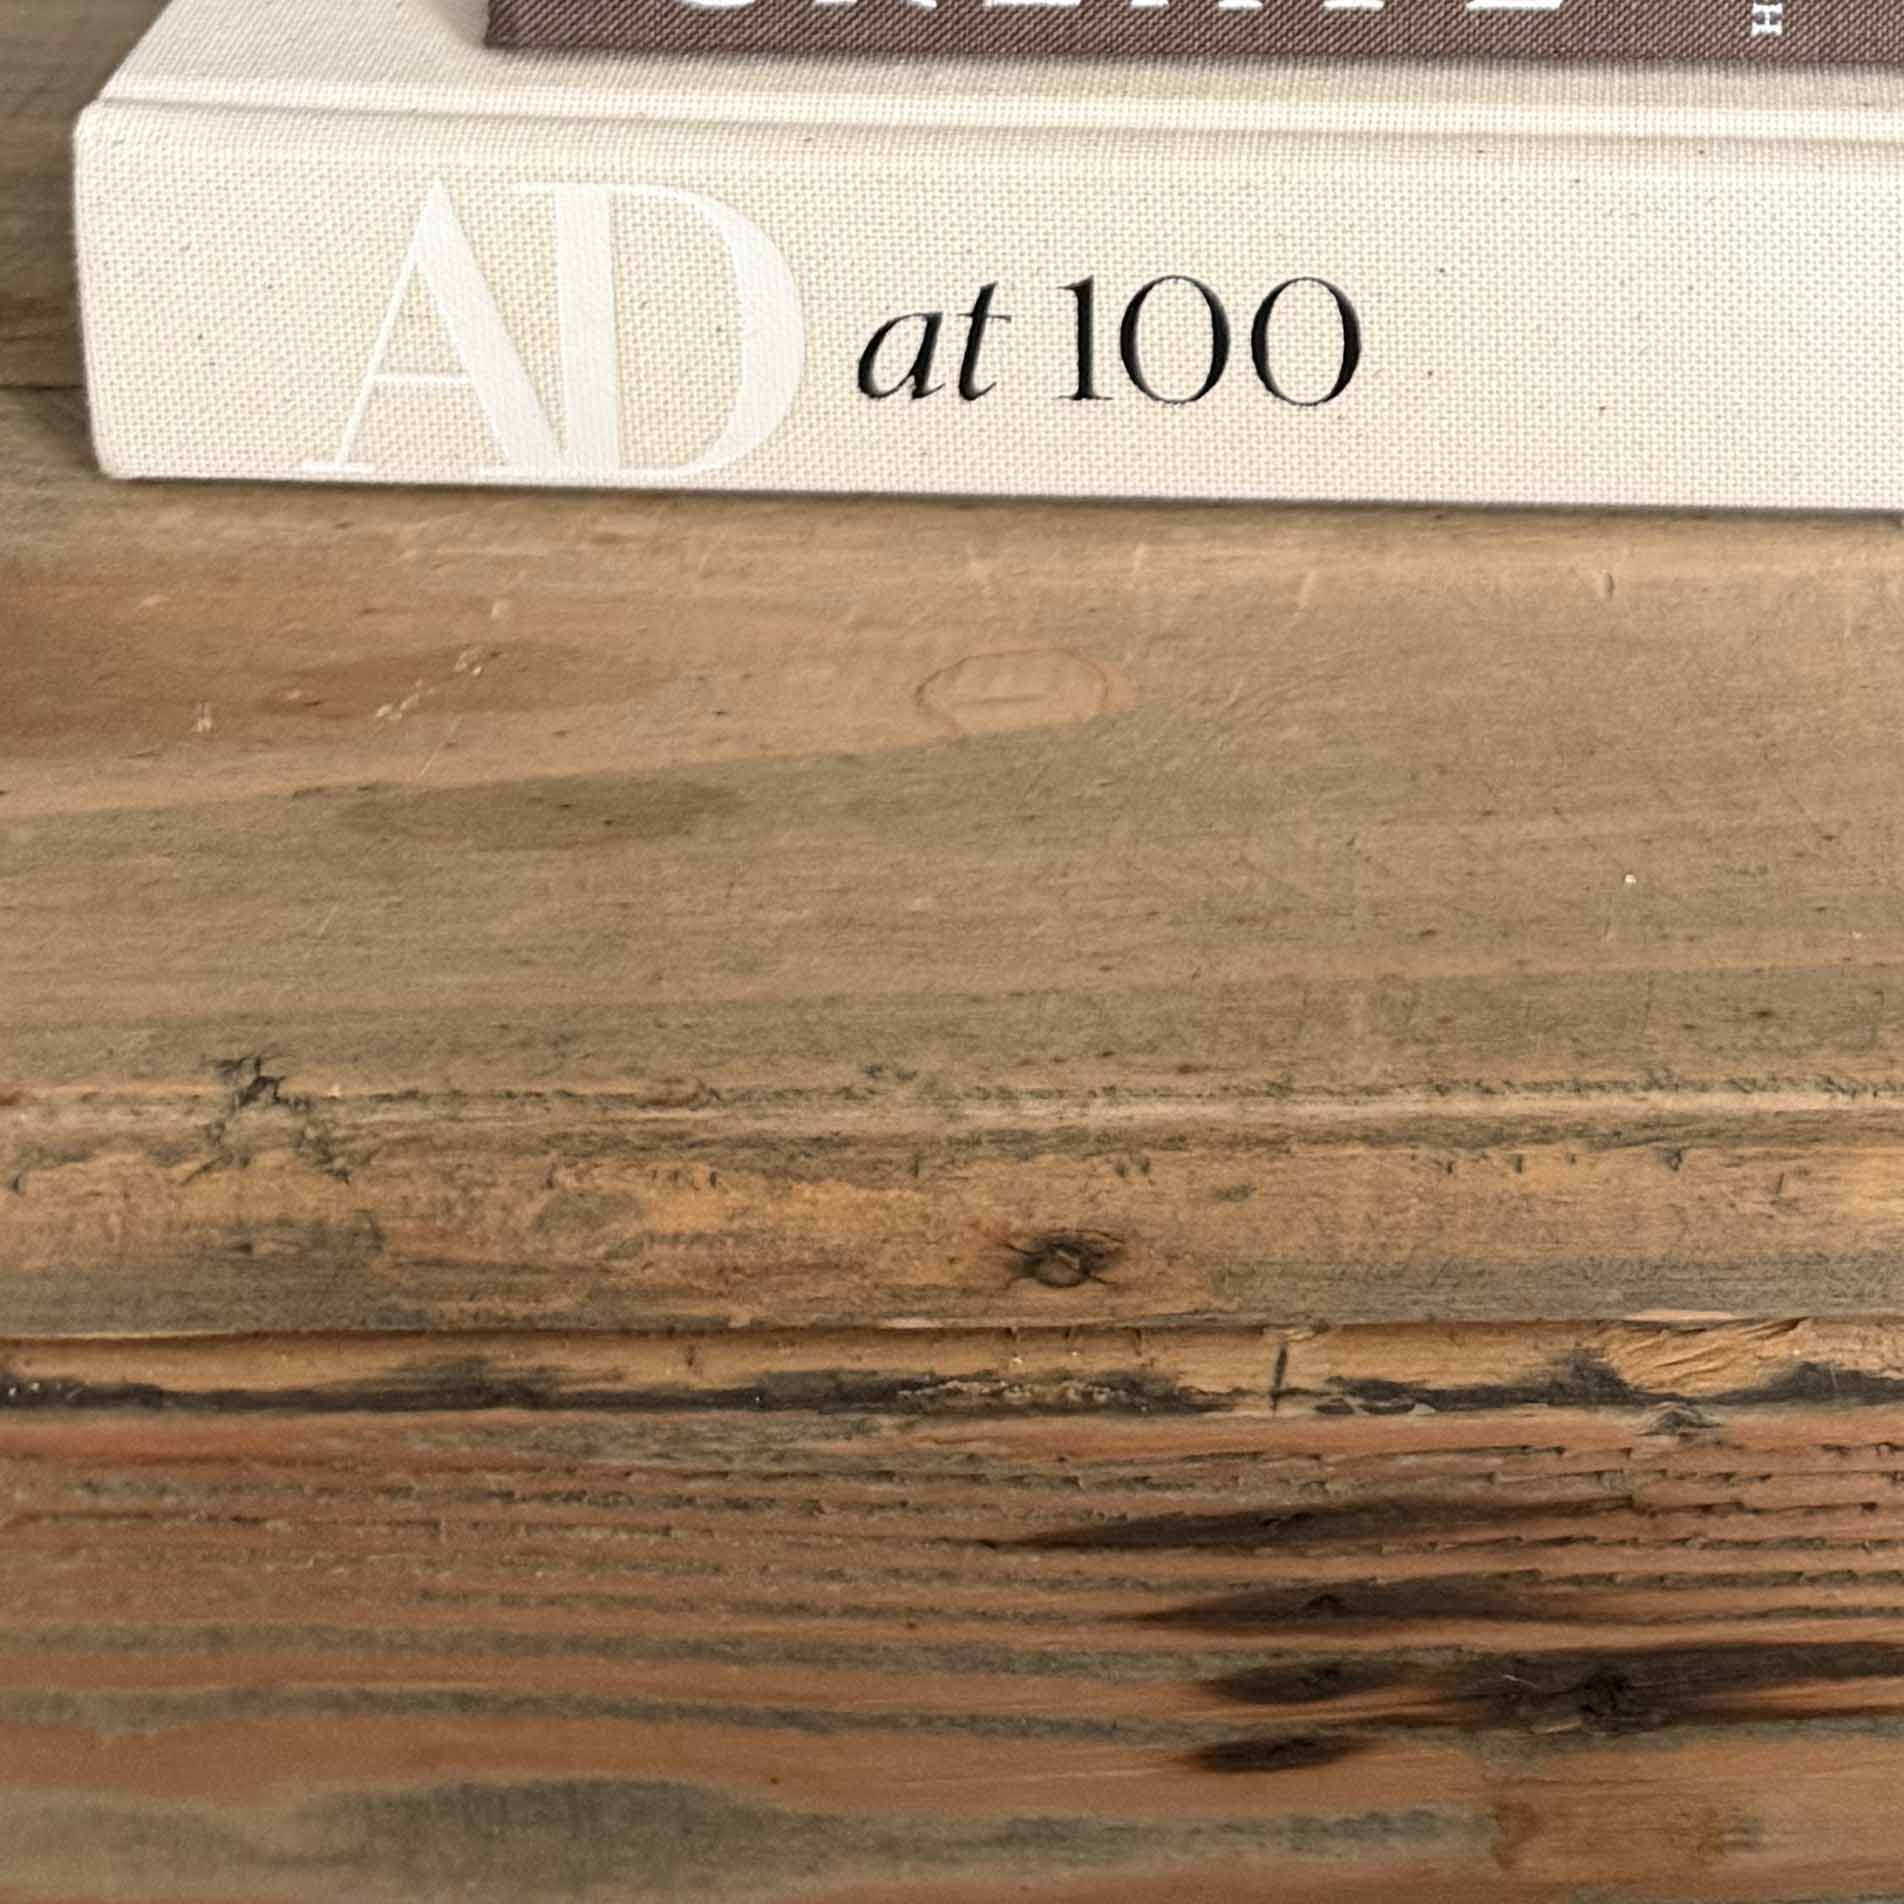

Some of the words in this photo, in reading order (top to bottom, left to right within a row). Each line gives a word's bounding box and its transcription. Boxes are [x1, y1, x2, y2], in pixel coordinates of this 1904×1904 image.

[292, 181, 805, 477] AD
[857, 282, 1012, 402] at
[1055, 274, 1362, 407] 100
